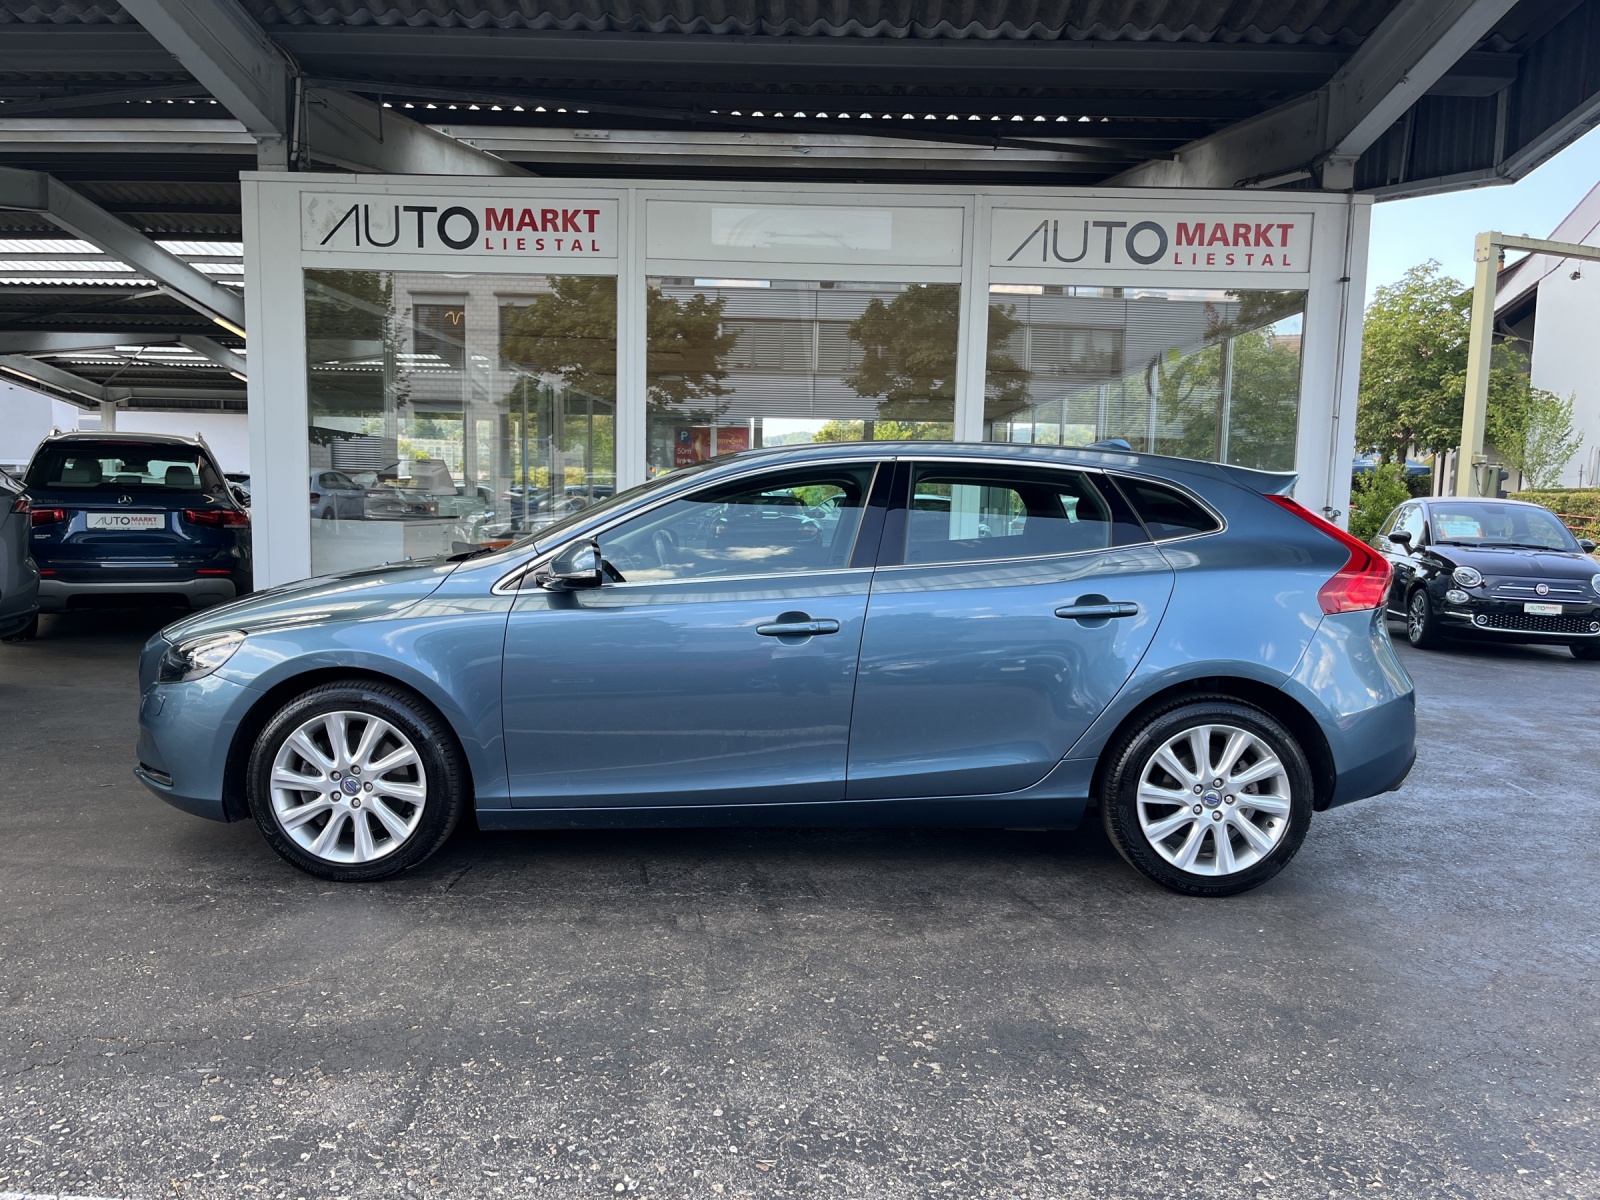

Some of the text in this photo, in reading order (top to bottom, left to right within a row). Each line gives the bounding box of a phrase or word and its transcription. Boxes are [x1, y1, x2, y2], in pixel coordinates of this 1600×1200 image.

[319, 203, 601, 250] AUTO MARKT
[485, 237, 601, 252] LIESTAL
[1006, 219, 1294, 266] AUTO MARKT
[1173, 252, 1293, 267] LIESTAL
[681, 431, 688, 440] P
[676, 447, 692, 455] 50m
[95, 516, 130, 526] AUTO
